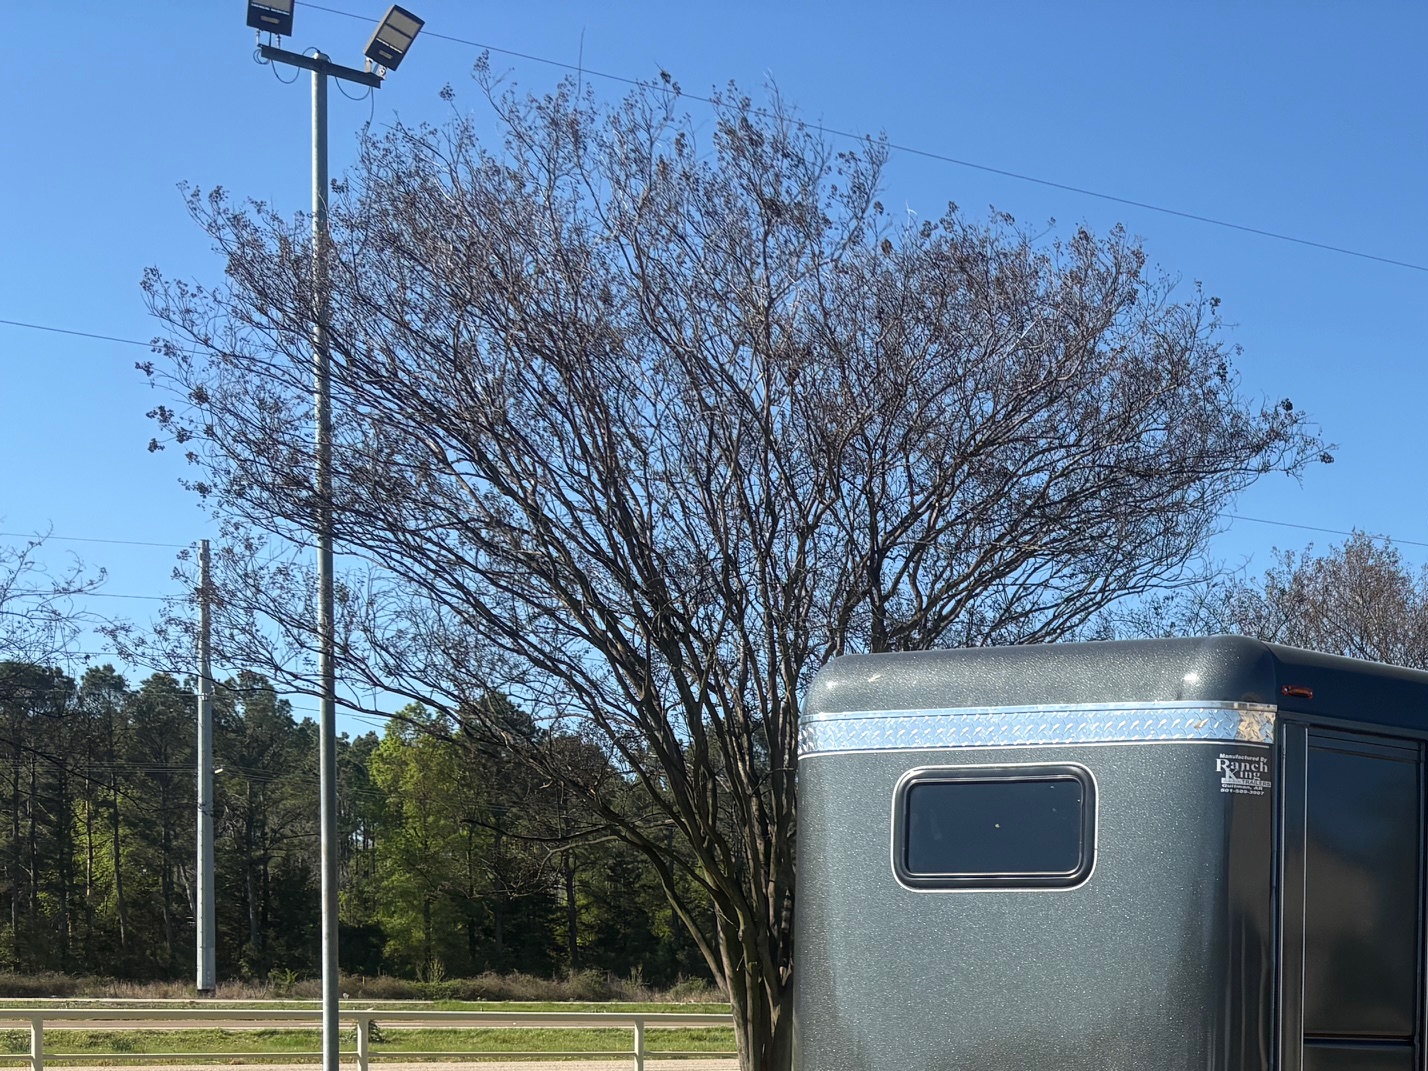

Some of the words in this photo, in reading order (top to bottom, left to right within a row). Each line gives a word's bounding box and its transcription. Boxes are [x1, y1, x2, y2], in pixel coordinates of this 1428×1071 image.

[1216, 758, 1268, 772] Ranch
[1225, 768, 1261, 781] King
[1242, 779, 1271, 787] TRAILERS
